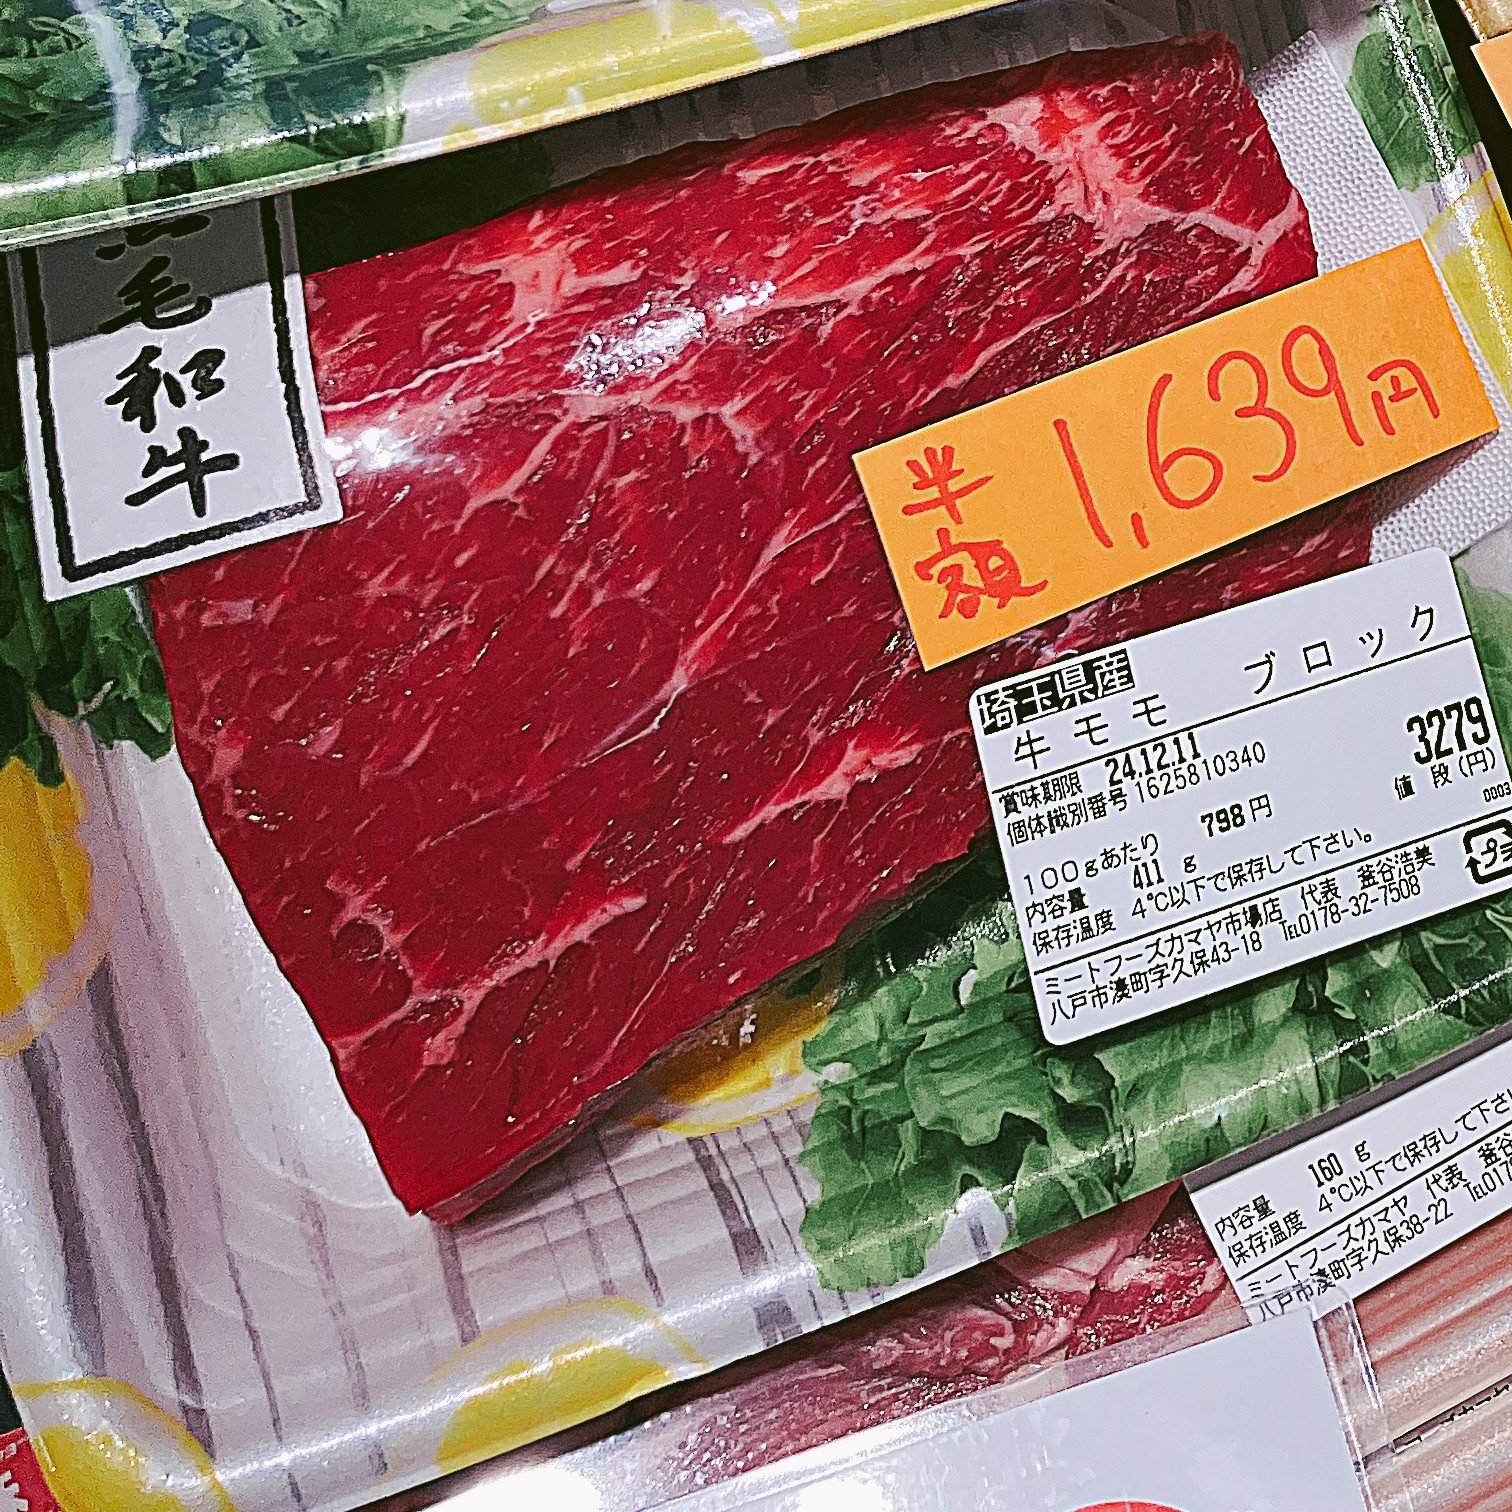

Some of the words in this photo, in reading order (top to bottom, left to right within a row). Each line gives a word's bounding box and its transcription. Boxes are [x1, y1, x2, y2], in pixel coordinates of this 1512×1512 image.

[1053, 324, 1440, 549] 1,639円
[902, 444, 1047, 620] 半額
[975, 648, 1135, 735] 埼玉県産
[1014, 694, 1167, 769] 牛モモ
[1244, 605, 1433, 694] ブロック
[1407, 696, 1490, 764] 3279
[999, 771, 1083, 818] 賞味期限
[1105, 732, 1201, 787] 24.12.11
[1007, 787, 1127, 847] 個体識別番号
[1135, 742, 1265, 802] 1625810340
[1483, 782, 1511, 802] 0003
[1026, 887, 1088, 928] 内容量
[1033, 909, 1116, 956] 保存温度
[1046, 898, 1282, 994] ミートフーズカマヤ市場店
[1301, 878, 1341, 910] 代表
[1215, 1195, 1275, 1241] 内容量
[1228, 1210, 1307, 1267] 保存温度
[1248, 1195, 1407, 1298] ミートフーズカマヤ
[1426, 1163, 1467, 1199] 代表
